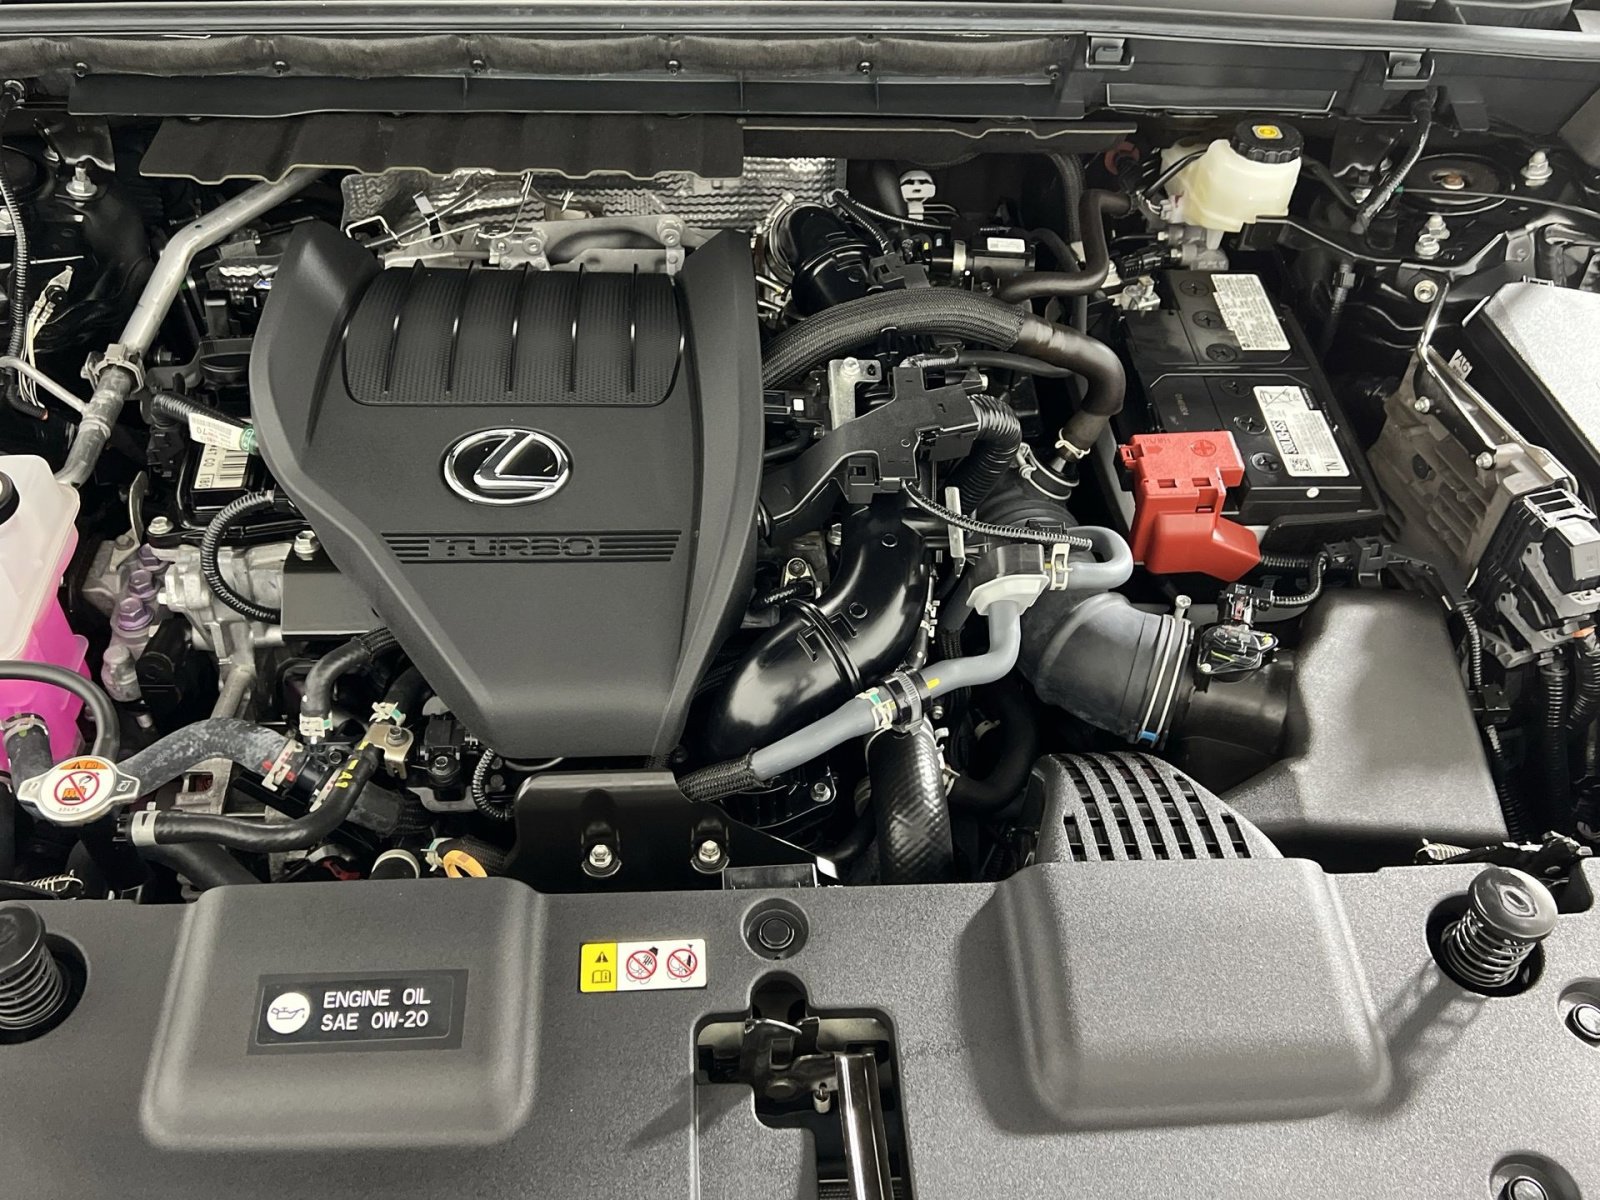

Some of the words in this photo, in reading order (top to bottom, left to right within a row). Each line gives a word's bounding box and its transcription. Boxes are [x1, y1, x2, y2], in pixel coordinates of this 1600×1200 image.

[434, 536, 595, 557] TURBO
[323, 989, 391, 1009] ENGINE
[402, 987, 431, 1006] OIL
[320, 1012, 359, 1031] SAE
